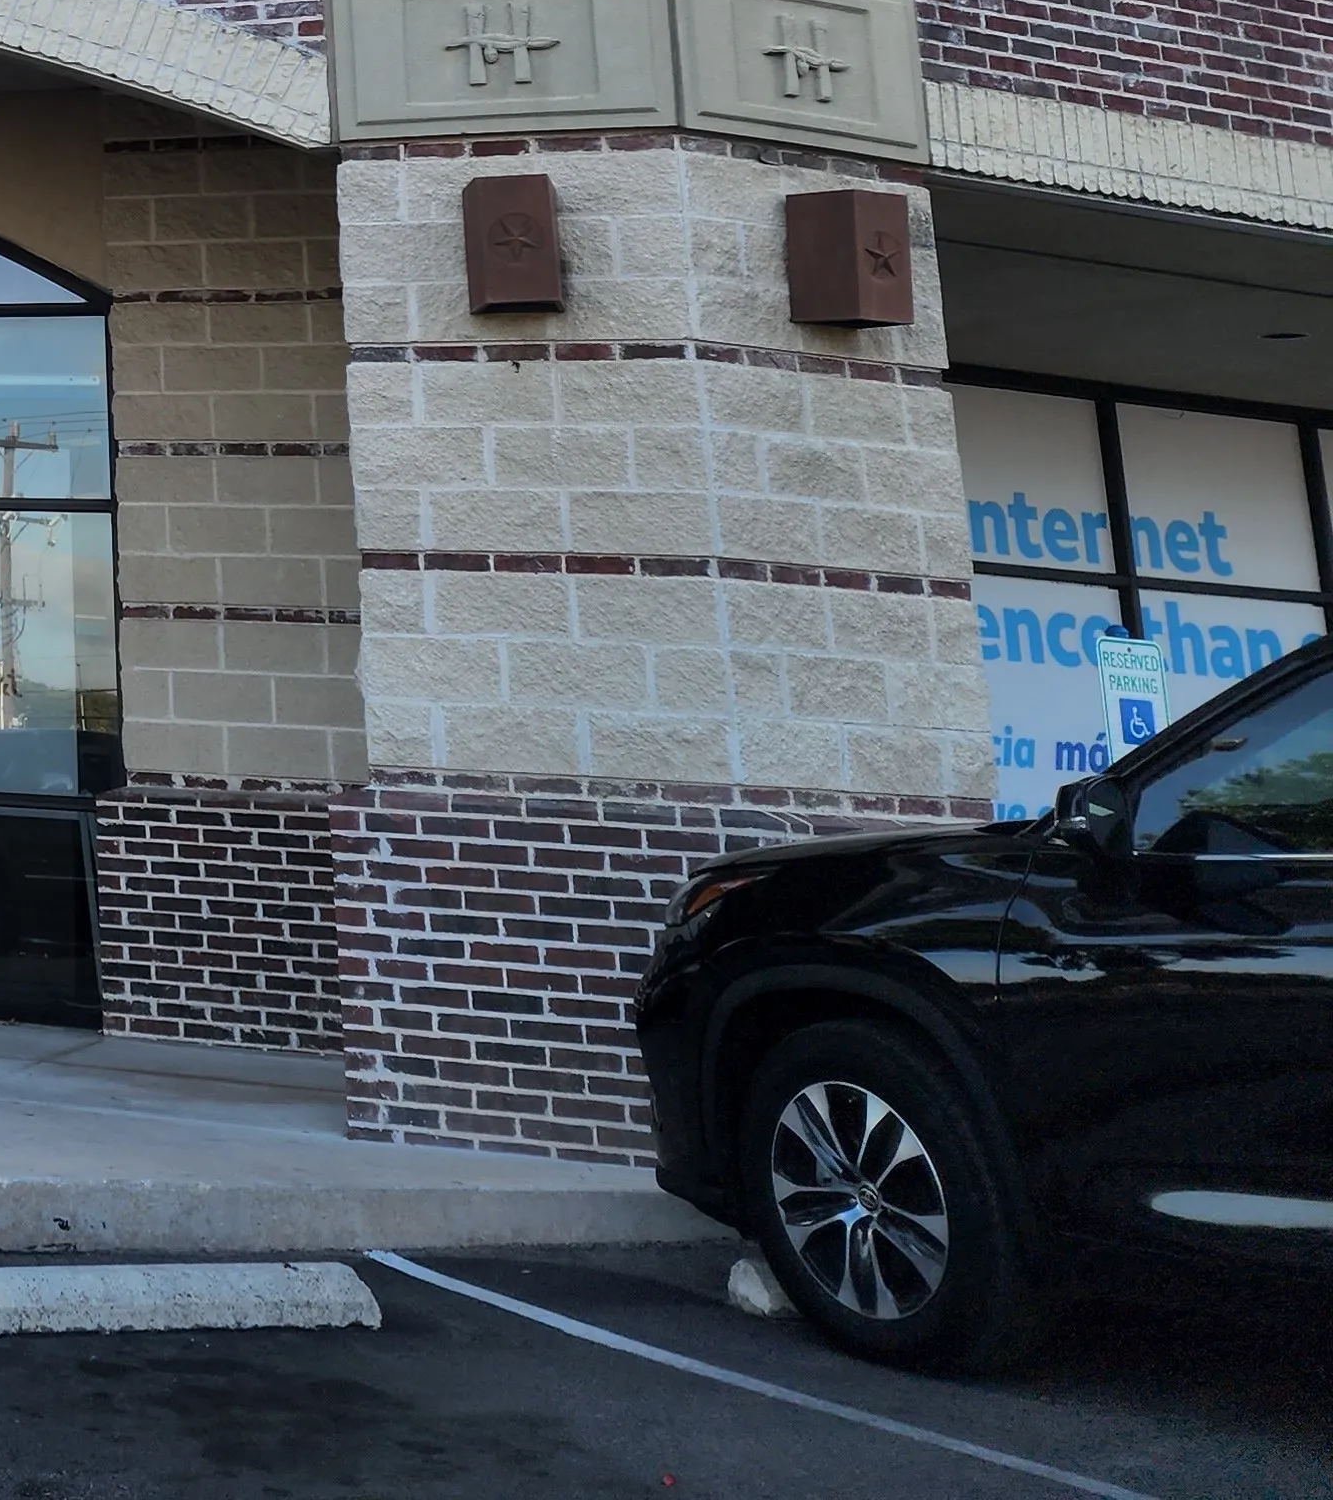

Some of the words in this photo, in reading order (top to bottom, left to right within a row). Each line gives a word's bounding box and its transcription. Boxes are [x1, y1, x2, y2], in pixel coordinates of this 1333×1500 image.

[968, 491, 1233, 577] nternet
[1102, 651, 1159, 672] RESERVED
[1109, 674, 1159, 695] PARKING
